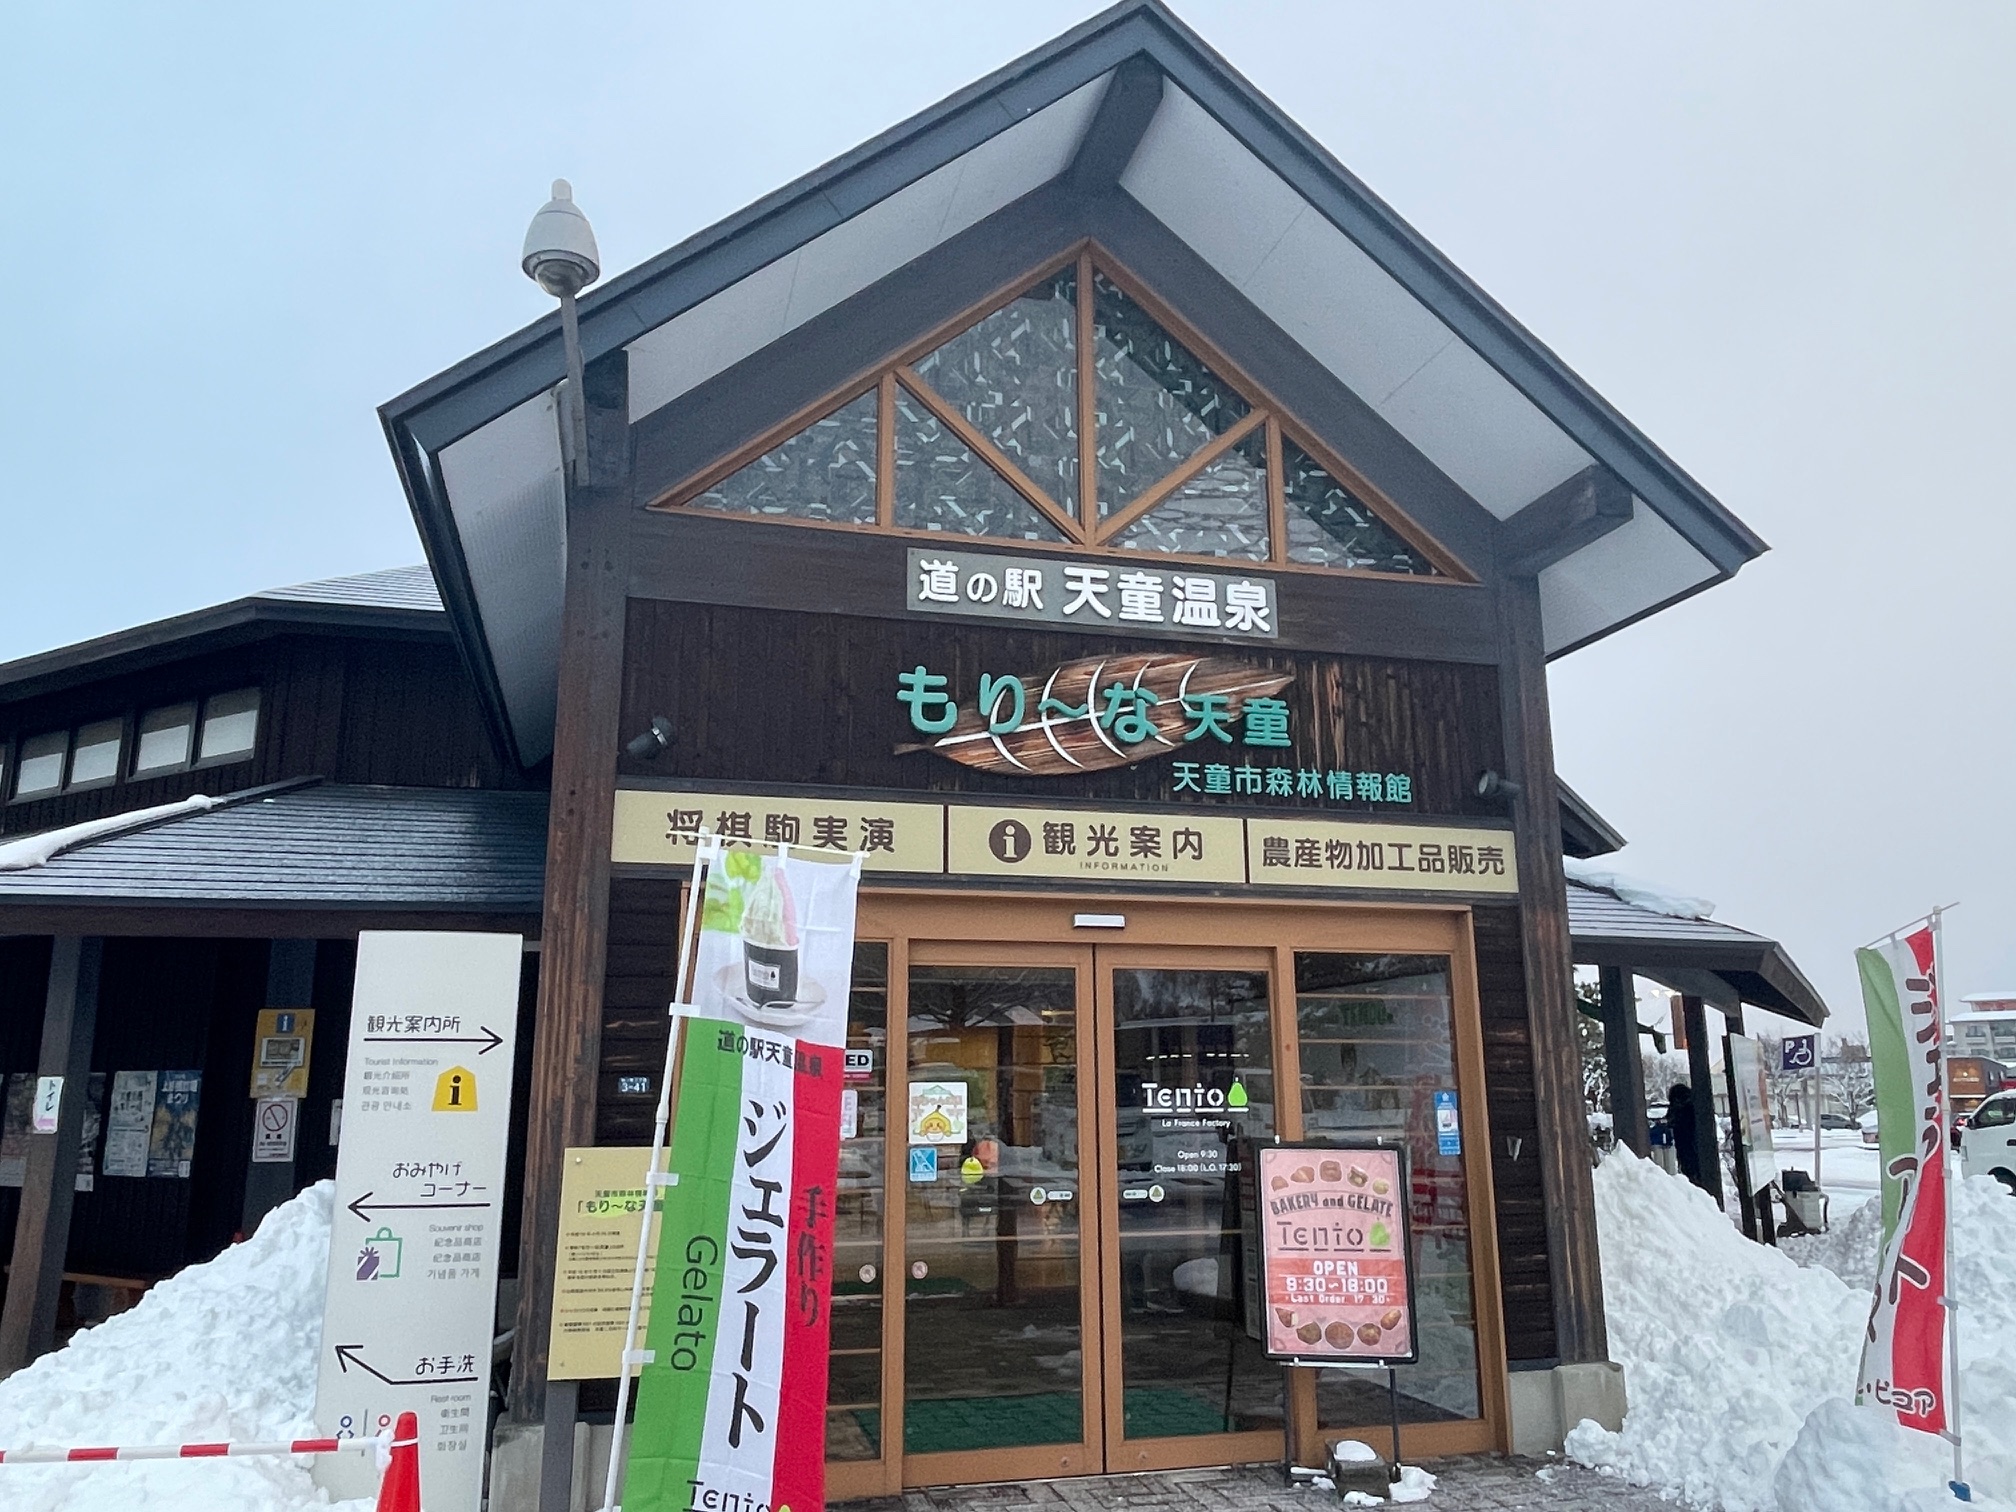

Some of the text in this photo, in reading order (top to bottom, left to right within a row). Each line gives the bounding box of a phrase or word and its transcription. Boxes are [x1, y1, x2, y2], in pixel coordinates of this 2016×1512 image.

[918, 559, 1271, 632] 道の駅 天童温泉
[1171, 761, 1413, 804] 天童市森林情報館
[665, 809, 896, 853] 将棋駒実演
[1043, 821, 1203, 861] 観光案内
[1262, 835, 1506, 876] 農産物加工品販売
[1080, 861, 1169, 872] INFORMATION
[367, 1014, 461, 1034] 観光案内所
[1784, 1040, 1796, 1053] P
[621, 1082, 646, 1093] 3-41
[1161, 1118, 1231, 1129] La France Factory
[1177, 1150, 1199, 1160] Open
[392, 1162, 463, 1179] おみやげ
[420, 1181, 487, 1198] コーナー
[1270, 1194, 1319, 1216] BAKERY
[1322, 1195, 1344, 1207] and
[1313, 1260, 1358, 1276] OPEN
[670, 1234, 718, 1372] Gelato
[1290, 1293, 1314, 1303] Last
[415, 1354, 475, 1375] お手洗
